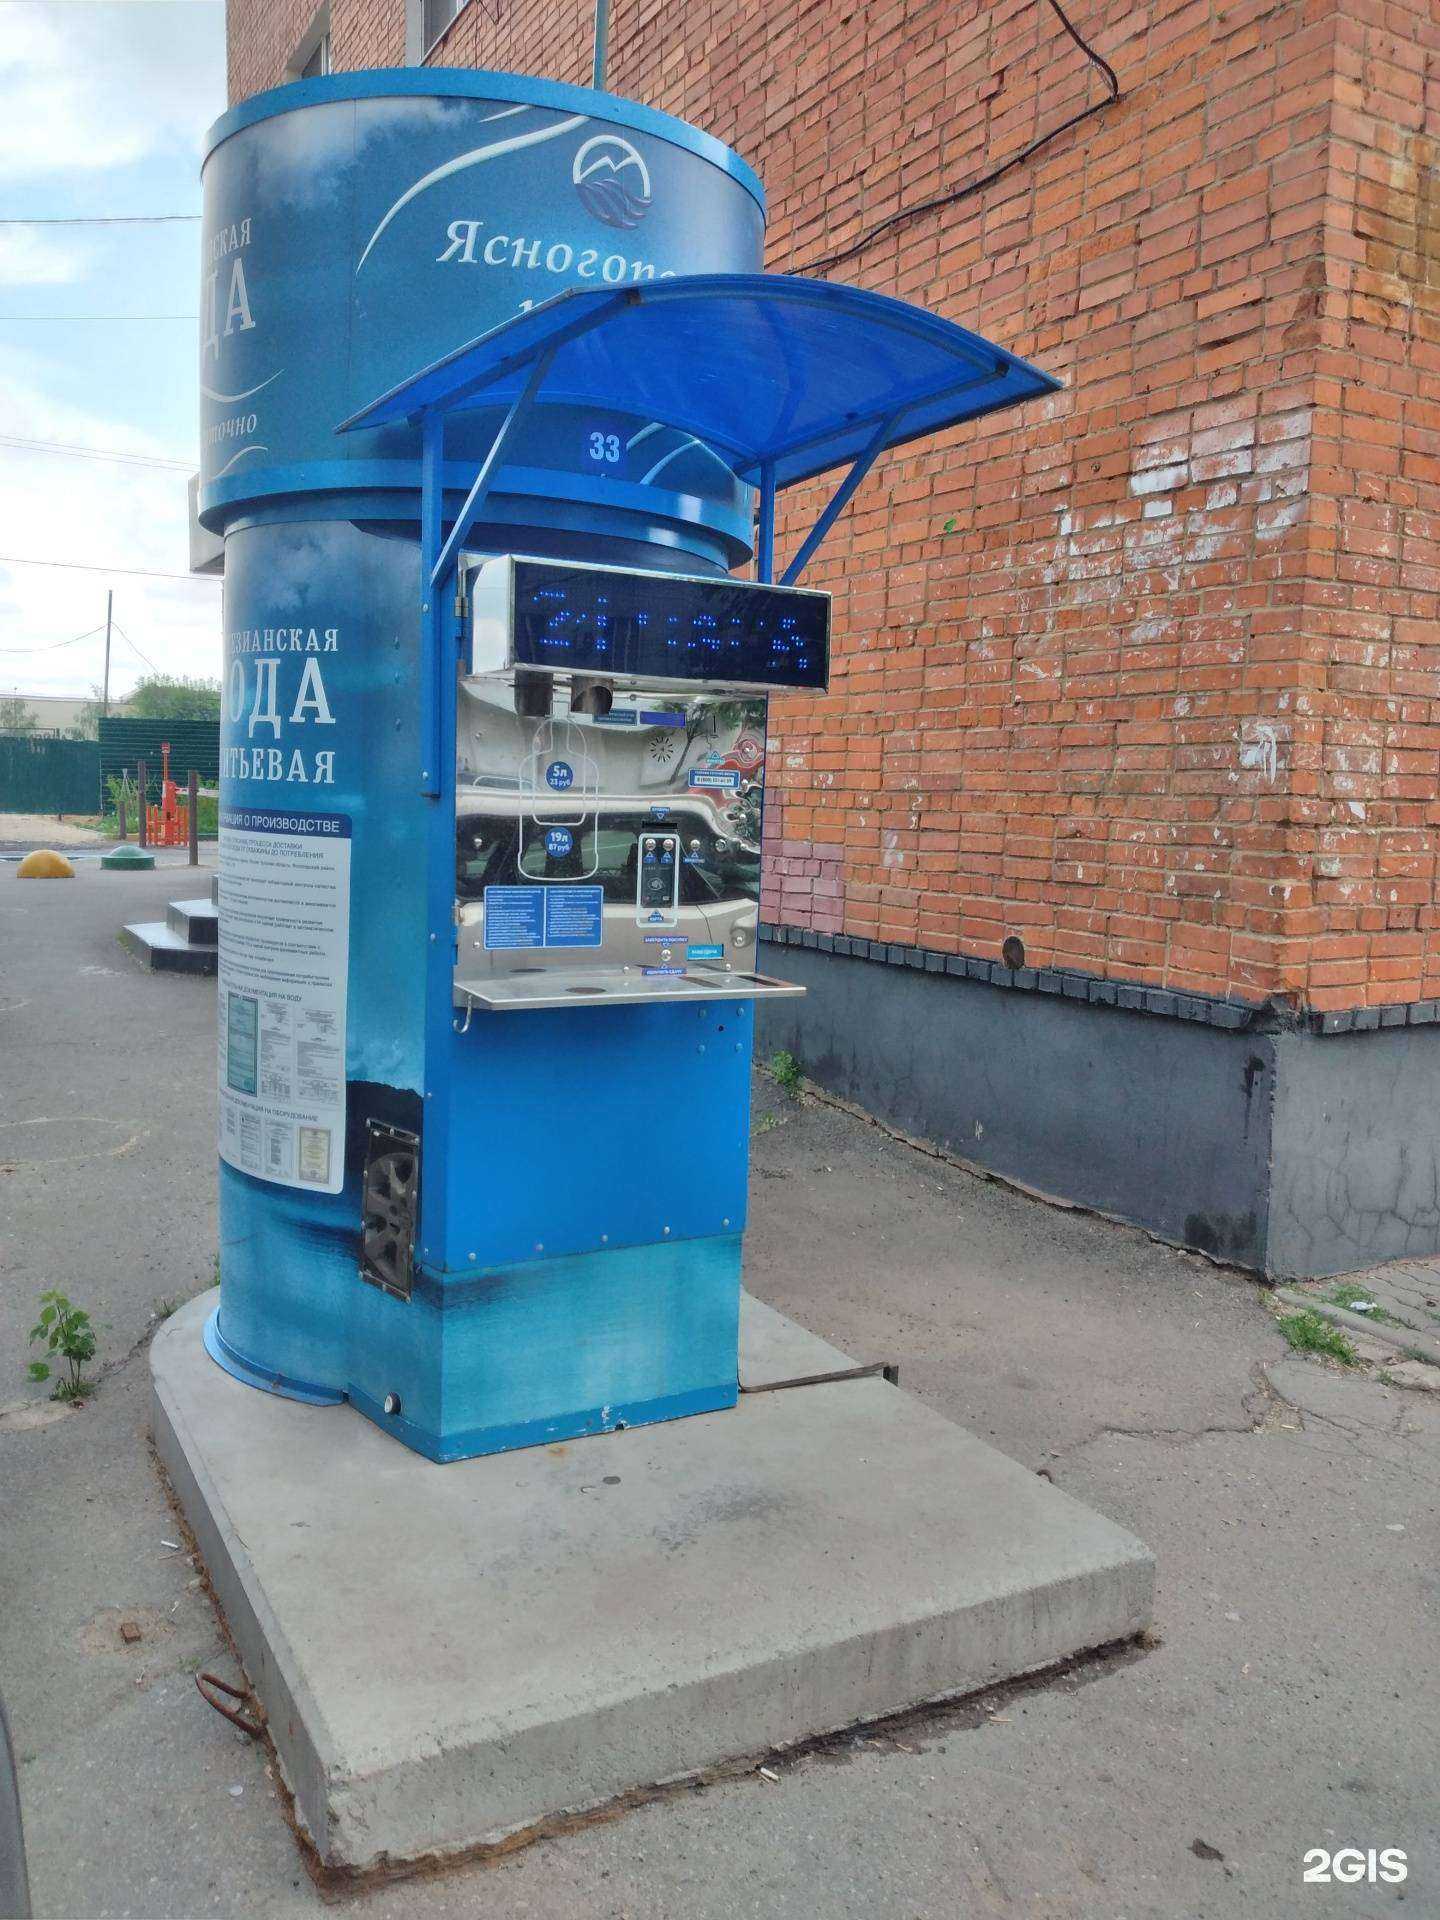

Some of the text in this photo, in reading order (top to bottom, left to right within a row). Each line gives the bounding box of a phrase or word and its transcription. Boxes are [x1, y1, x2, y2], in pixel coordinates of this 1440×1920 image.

[589, 430, 620, 463] 33
[231, 628, 339, 656] ЕЗИАНСКАЯ
[229, 657, 337, 739] ОДА
[222, 748, 336, 784] ИТЬЕВАЯ
[553, 765, 568, 778] 5л
[252, 815, 340, 832] ПРОИЗВОДСТВЕ
[550, 832, 568, 842] 19л
